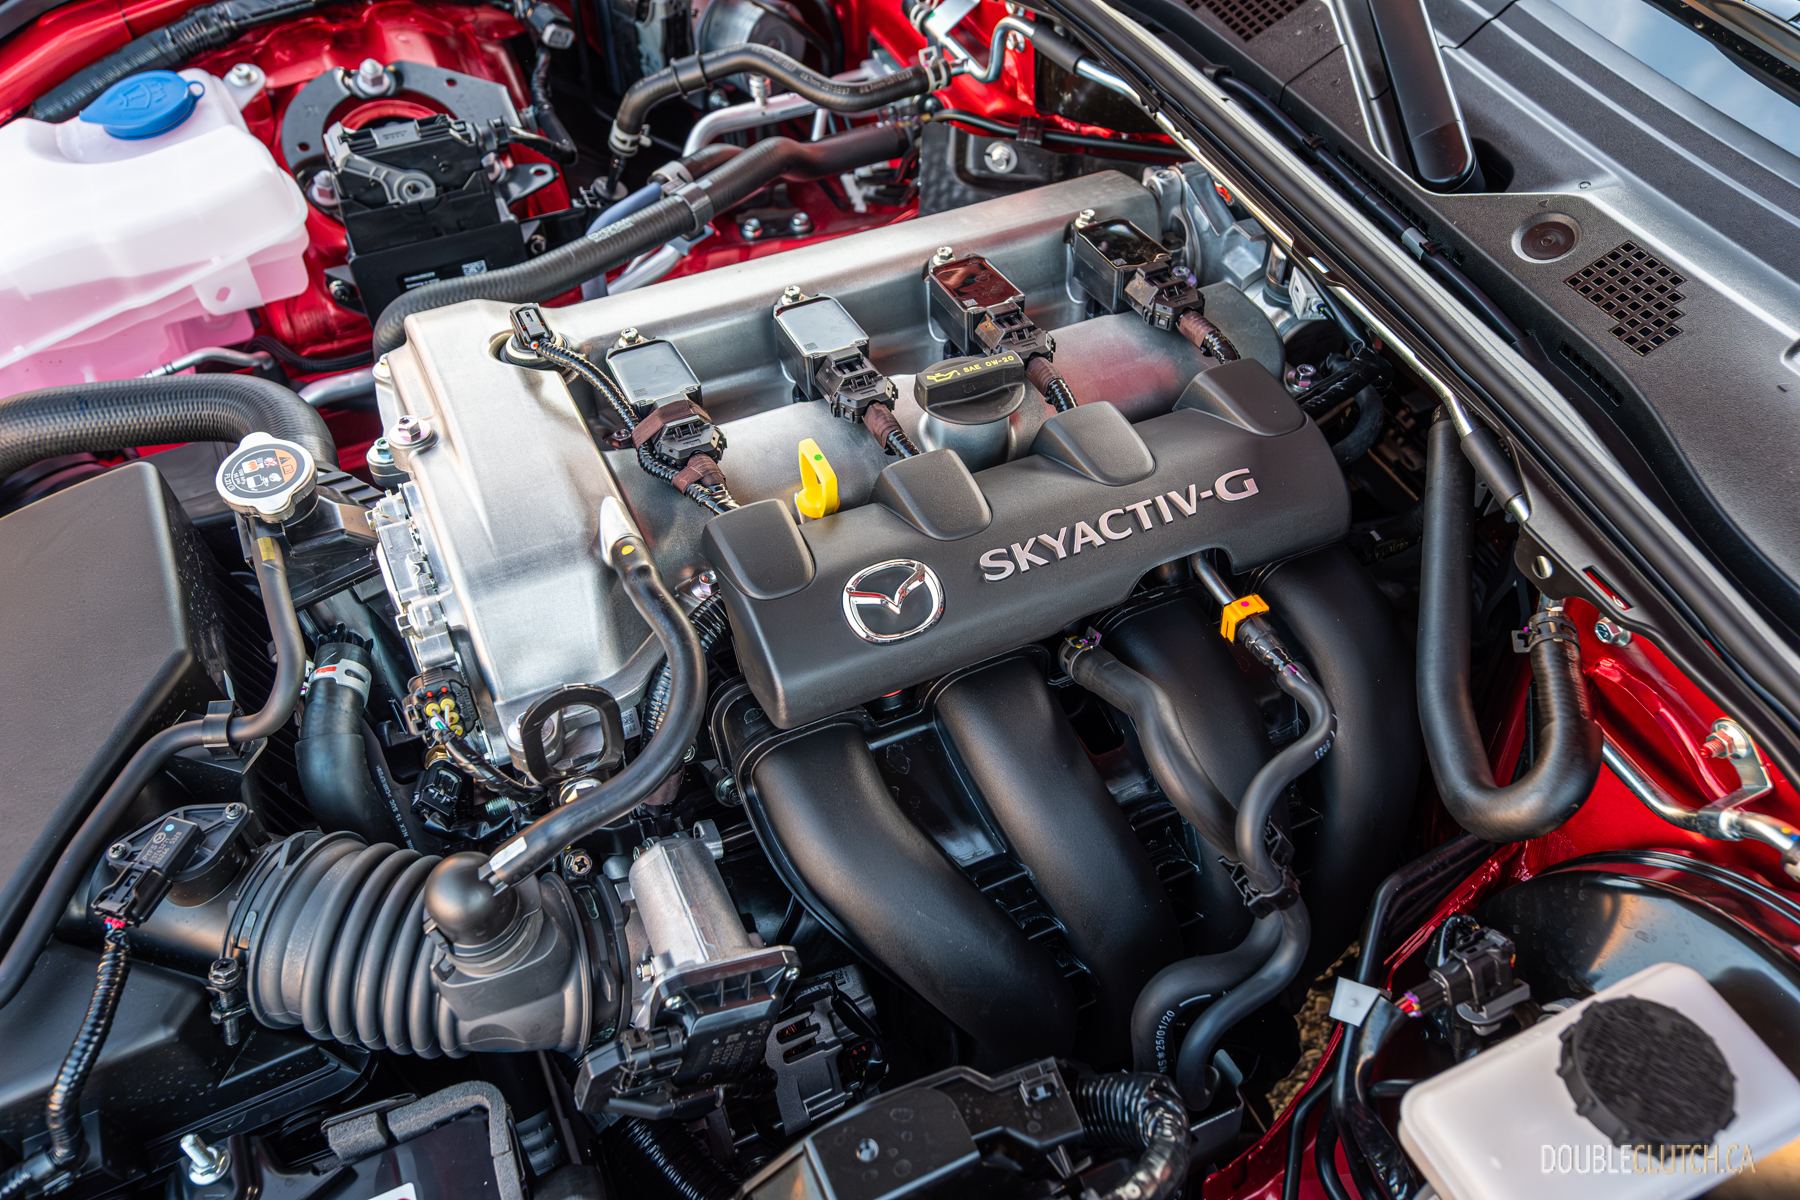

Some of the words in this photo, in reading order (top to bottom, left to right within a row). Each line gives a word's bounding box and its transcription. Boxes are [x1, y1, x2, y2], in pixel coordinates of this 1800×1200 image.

[963, 364, 982, 373] SAE
[985, 355, 1014, 367] 0W-20
[979, 468, 1259, 583] SKYACTIV-G
[142, 844, 157, 860] PYFS
